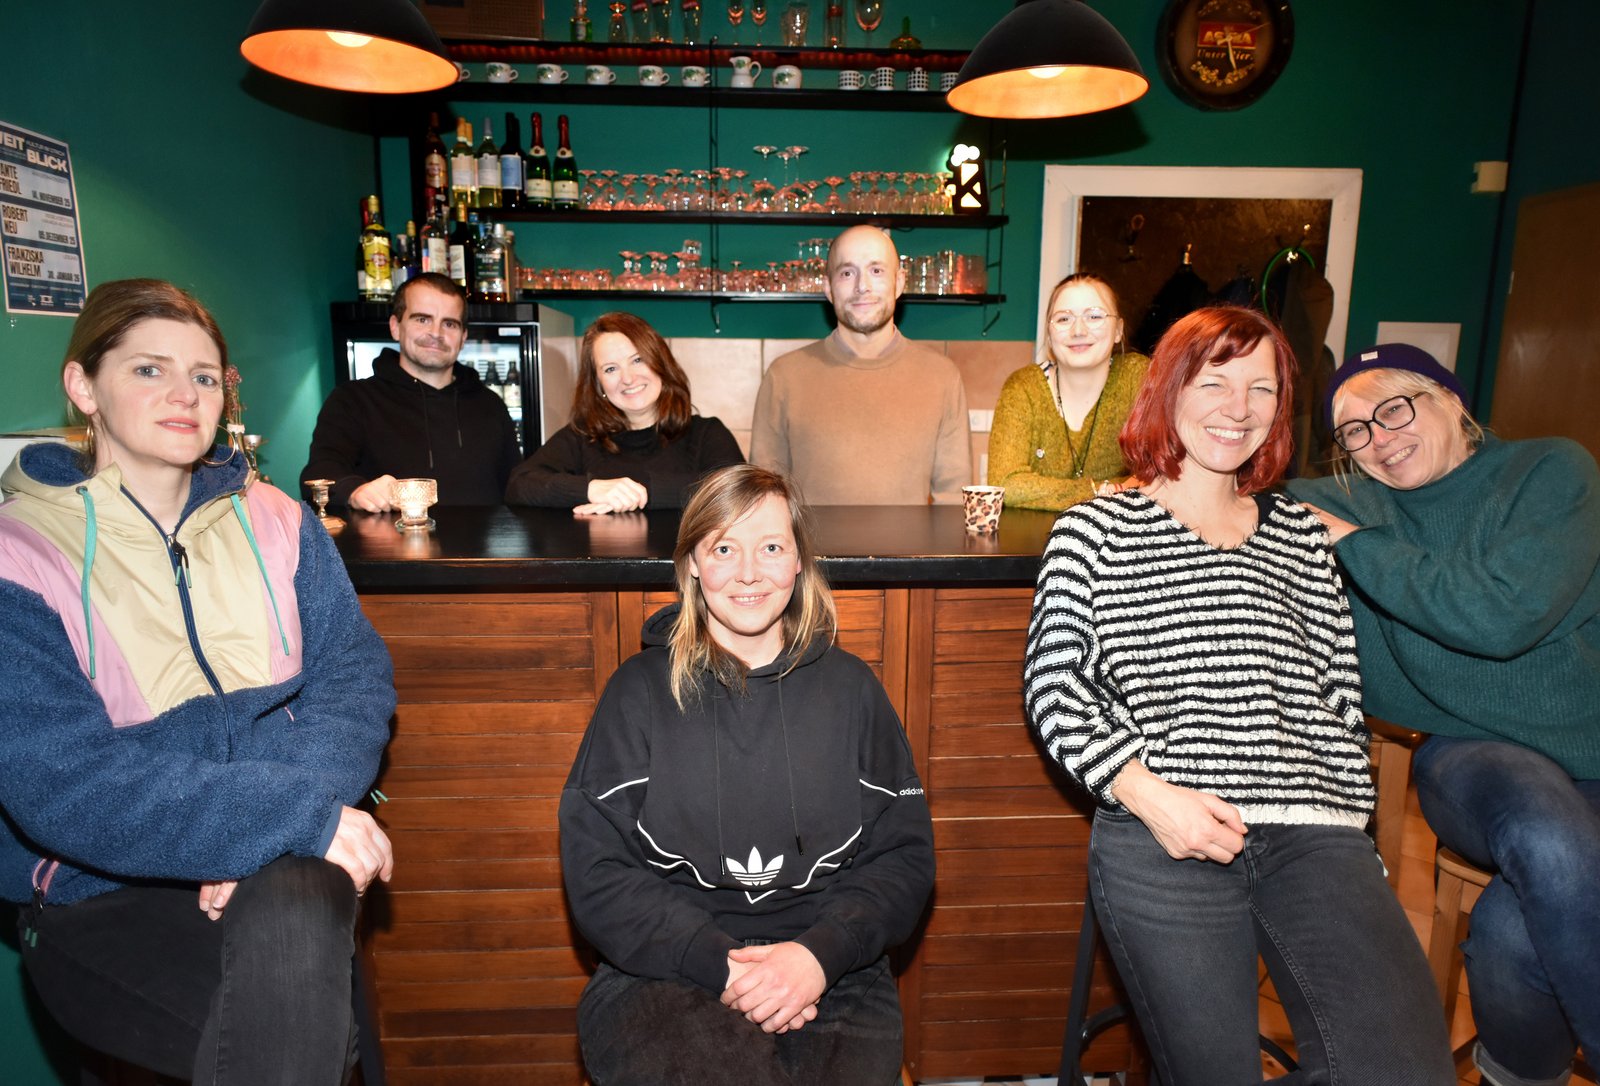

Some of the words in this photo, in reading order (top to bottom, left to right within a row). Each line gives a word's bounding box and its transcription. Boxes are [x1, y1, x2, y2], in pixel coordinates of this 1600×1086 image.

[1203, 31, 1252, 44] ASRA
[0, 131, 25, 151] EIT
[27, 149, 68, 173] BLICK
[2, 204, 28, 222] ROBERT
[4, 220, 18, 235] NEU
[7, 246, 44, 264] FRANZISKA
[9, 261, 42, 277] WILHELM
